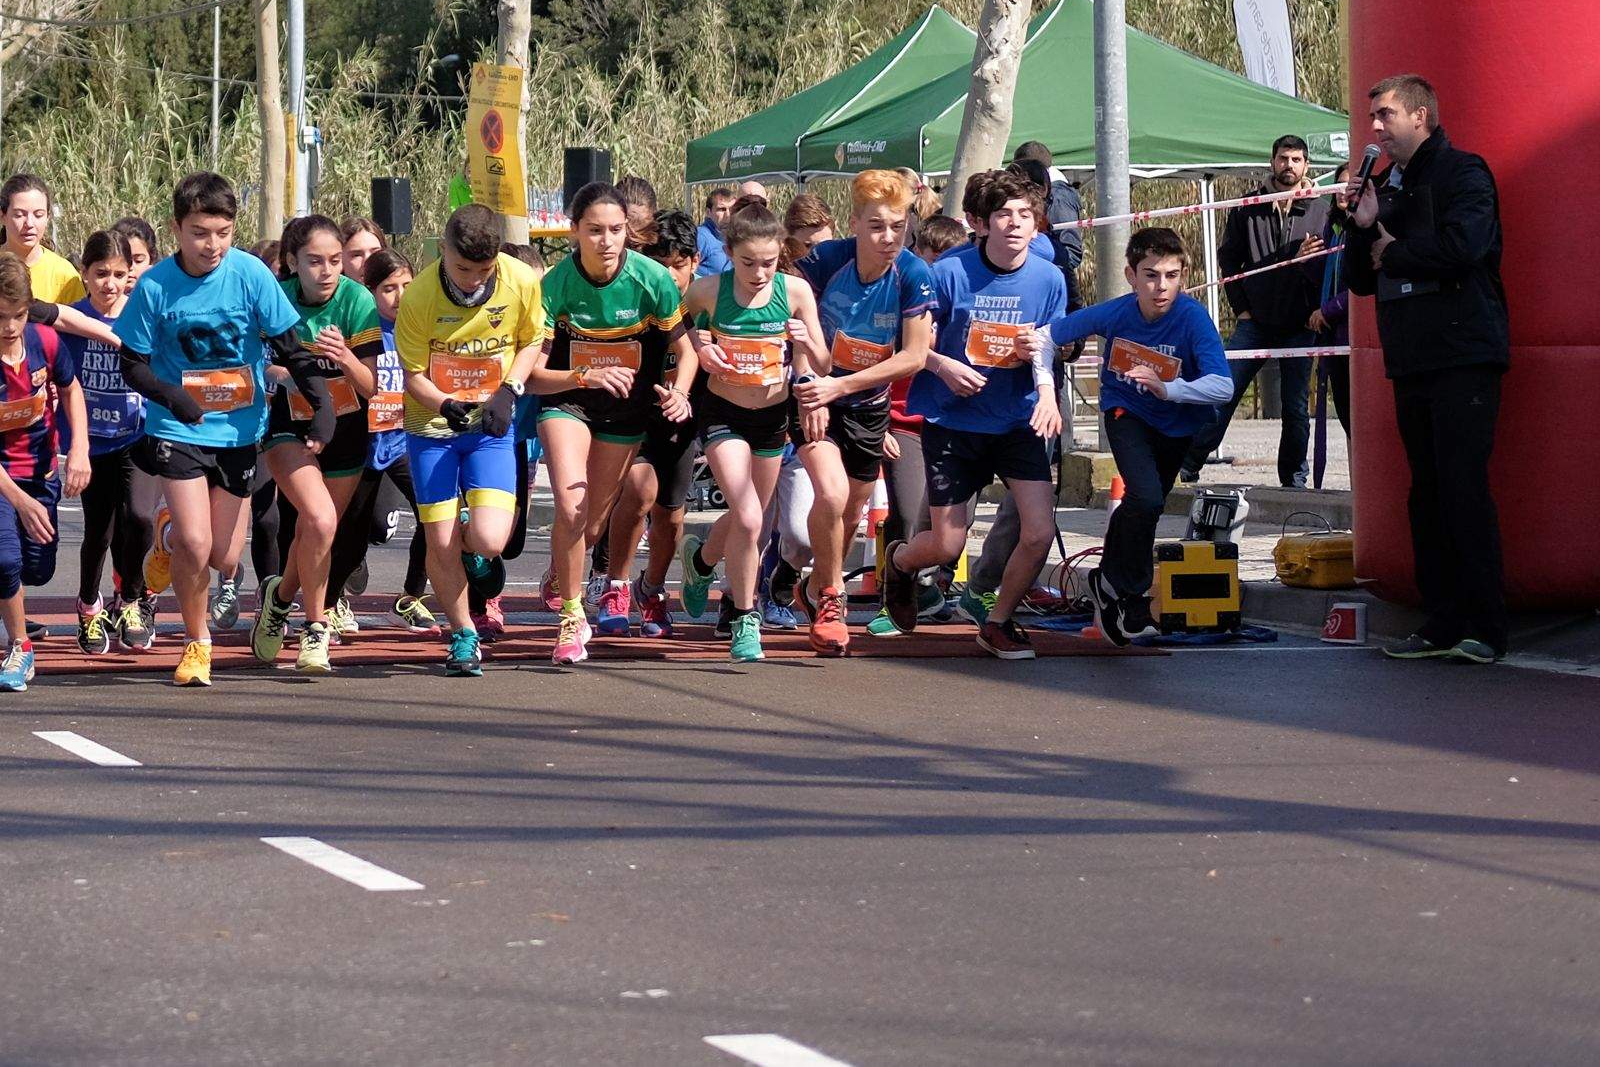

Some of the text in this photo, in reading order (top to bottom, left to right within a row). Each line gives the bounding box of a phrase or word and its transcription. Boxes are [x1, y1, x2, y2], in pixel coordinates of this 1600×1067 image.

[974, 295, 1020, 308] INSTITUT
[987, 344, 1014, 357] 527
[591, 356, 622, 365] DUNA
[732, 352, 767, 362] NEREA
[453, 378, 481, 389] 514
[205, 392, 233, 402] 522
[2, 407, 32, 422] 555
[92, 407, 121, 423] 803
